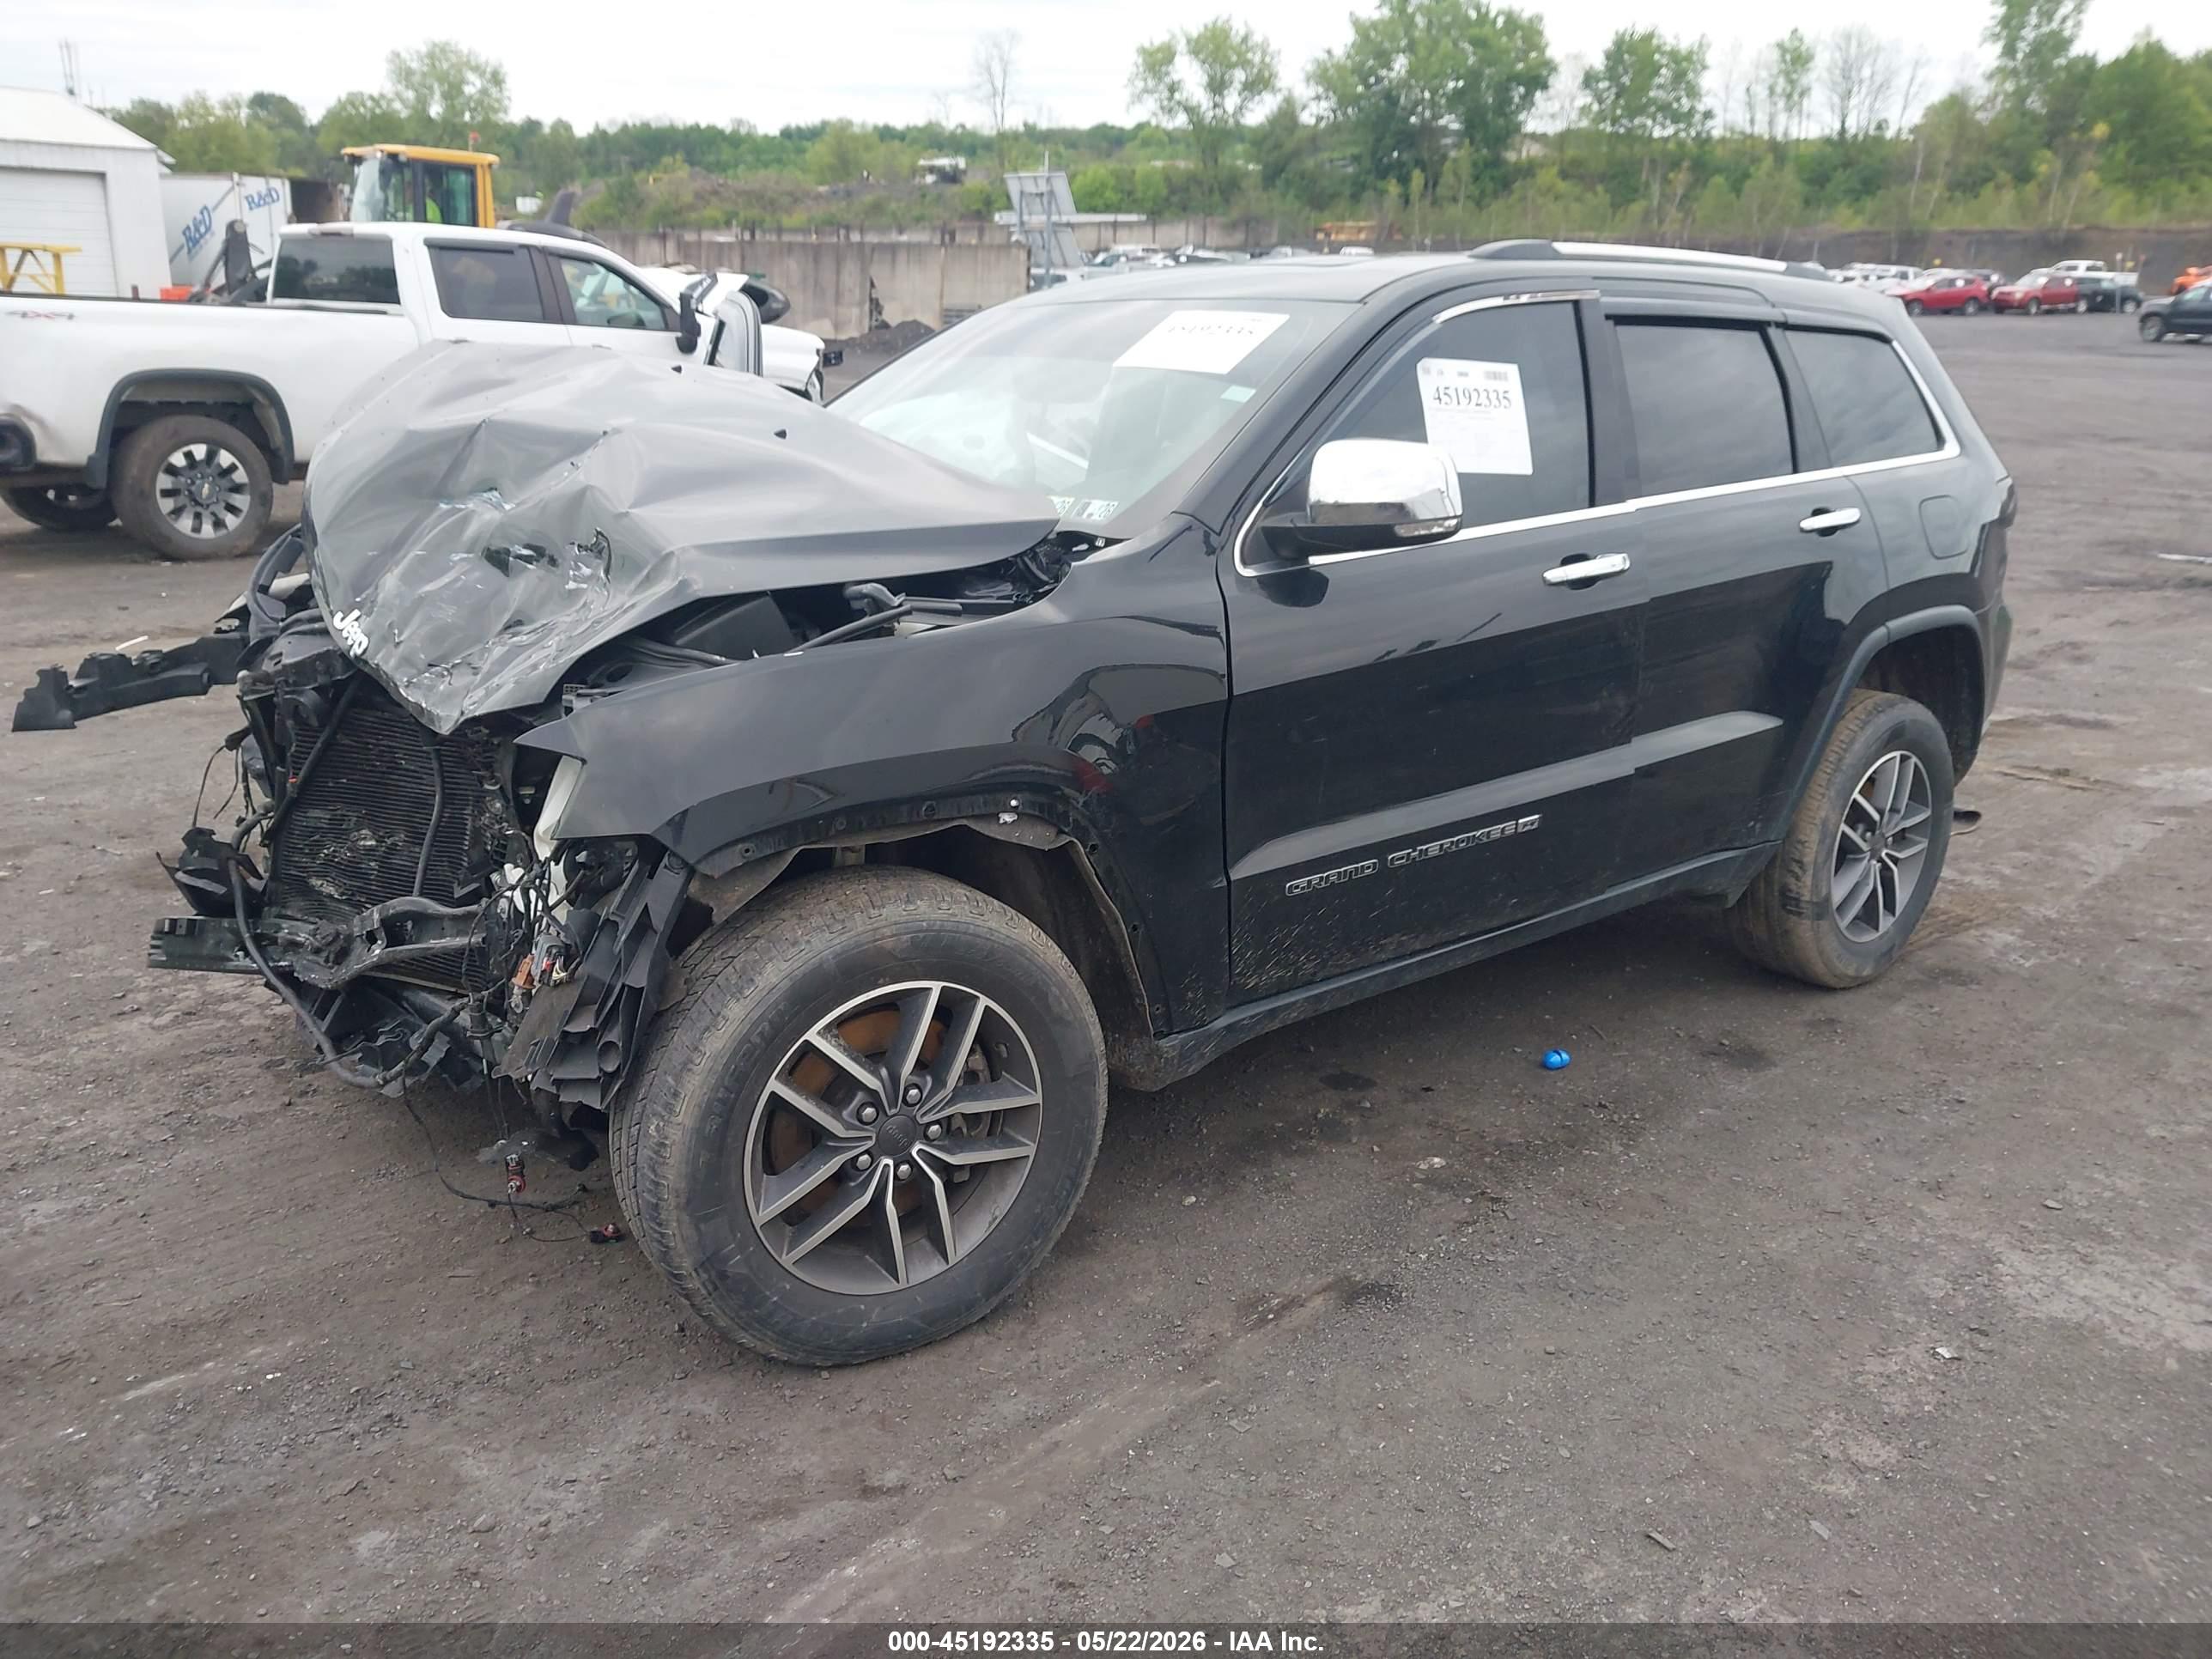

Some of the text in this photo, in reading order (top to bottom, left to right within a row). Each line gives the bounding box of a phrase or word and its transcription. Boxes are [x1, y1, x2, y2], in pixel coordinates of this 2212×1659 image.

[245, 186, 280, 211] R&D
[182, 204, 212, 255] R&D
[1432, 386, 1512, 410] 45192335
[332, 608, 370, 659] Jeep
[1387, 814, 1540, 868] CHEROKEE
[1285, 859, 1379, 896] GRAND
